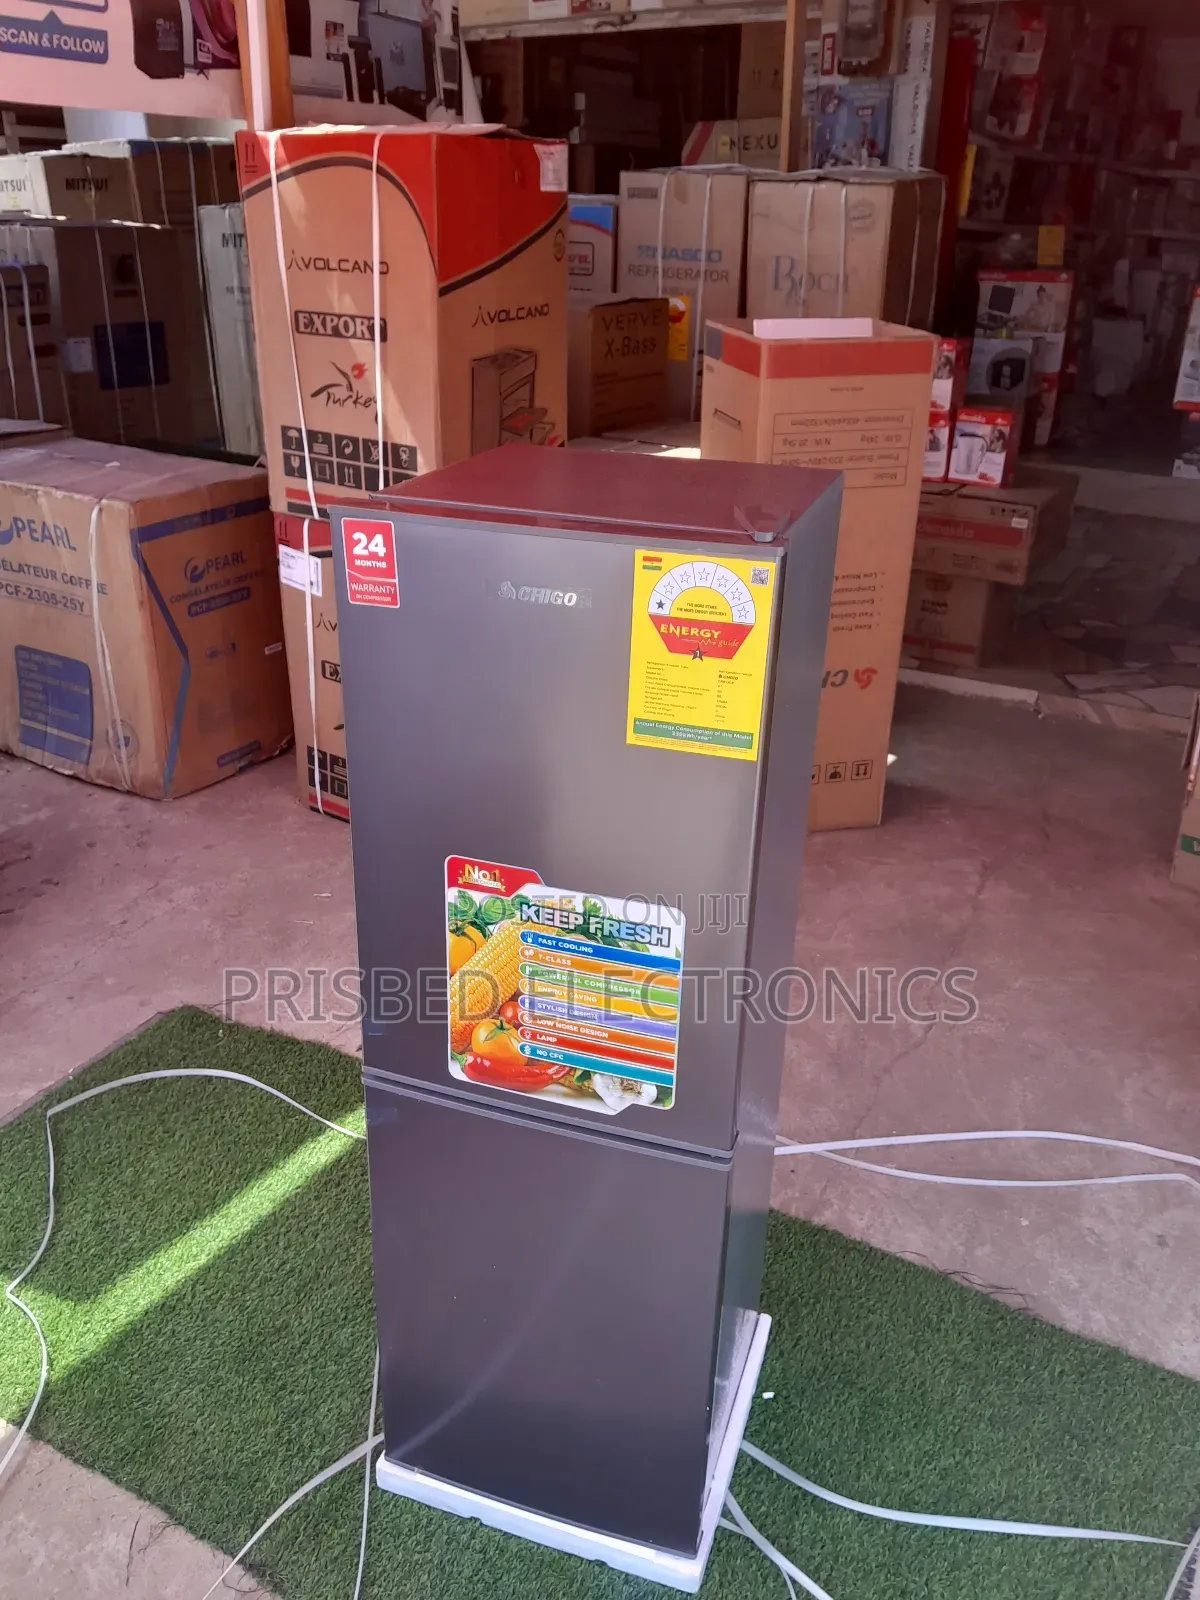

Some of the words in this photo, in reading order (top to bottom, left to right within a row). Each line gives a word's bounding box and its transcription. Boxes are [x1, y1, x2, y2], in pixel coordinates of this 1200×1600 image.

[0, 27, 39, 46] SCAN
[41, 32, 50, 48] &
[53, 34, 105, 55] FOLLOW
[730, 133, 778, 152] NEXU
[0, 179, 27, 192] ITSUI
[221, 232, 245, 248] MIT
[301, 256, 390, 275] VOLCANO
[627, 263, 730, 283] REFRIGERATOR
[487, 302, 550, 324] VOLCANO
[602, 308, 663, 332] VERVE
[604, 335, 657, 359] X-Bass
[13, 516, 77, 552] PEARL
[351, 531, 388, 557] 24
[205, 549, 248, 574] PEARL
[354, 558, 388, 569] MONTHS
[0, 557, 58, 582] ÉLATEUR
[61, 572, 108, 596] COFFE
[350, 582, 395, 595] WARRANTY
[517, 585, 578, 607] CHIGO
[659, 621, 722, 639] ENERGY
[717, 637, 740, 648] guide
[520, 901, 585, 931] KEEP
[588, 915, 672, 948] FRESH
[538, 937, 556, 947] FAST
[558, 940, 594, 954] COOLING
[538, 954, 572, 966] T-CLASS
[537, 969, 582, 984] POWERFUL
[584, 978, 641, 996] COMPRESSOR
[569, 992, 598, 1003] SAVING
[536, 1002, 568, 1014] STYLISH
[568, 1008, 598, 1020] DESIGN
[536, 1017, 554, 1027] LOW
[555, 1022, 579, 1033] NOISE
[580, 1026, 609, 1039] DESIGN
[536, 1033, 558, 1043] LAMP
[536, 1050, 548, 1058] NO
[549, 1052, 564, 1060] CFC
